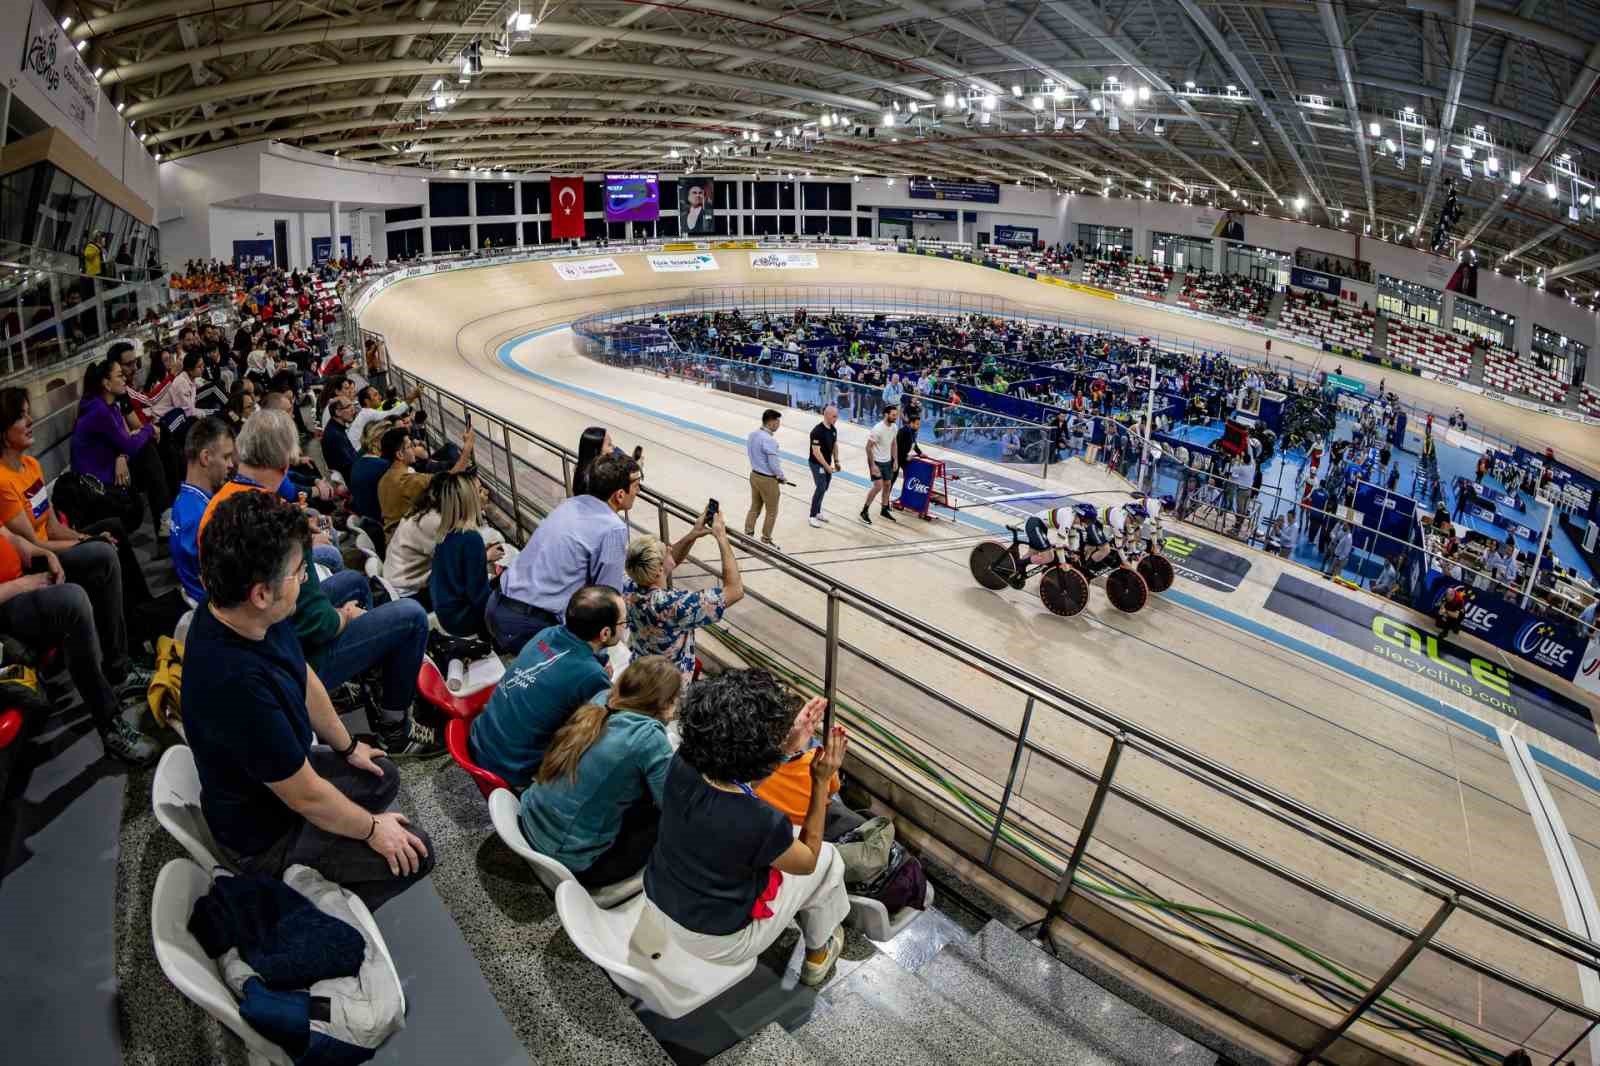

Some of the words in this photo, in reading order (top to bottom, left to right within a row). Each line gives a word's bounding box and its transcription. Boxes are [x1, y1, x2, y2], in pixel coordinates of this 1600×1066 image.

[1462, 602, 1499, 630] UEC
[1539, 638, 1574, 665] UEC
[1372, 643, 1521, 717] alecycling.com
